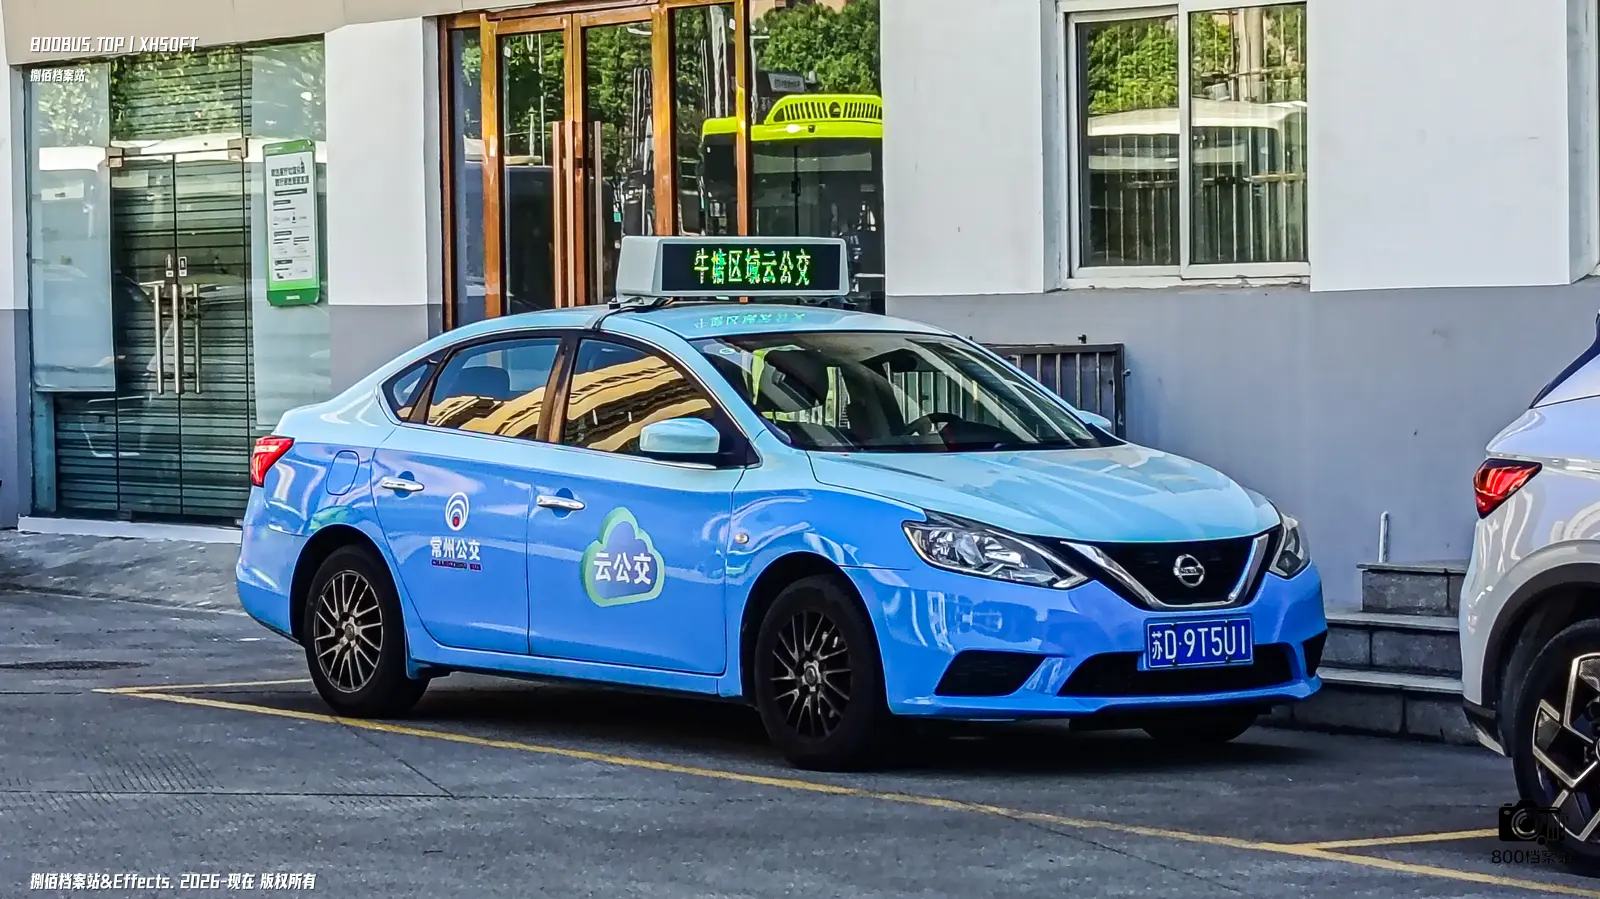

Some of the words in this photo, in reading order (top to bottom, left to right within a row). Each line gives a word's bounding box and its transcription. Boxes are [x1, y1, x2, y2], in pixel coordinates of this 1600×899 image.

[430, 536, 481, 561] 常州公交
[594, 552, 652, 585] 云公交
